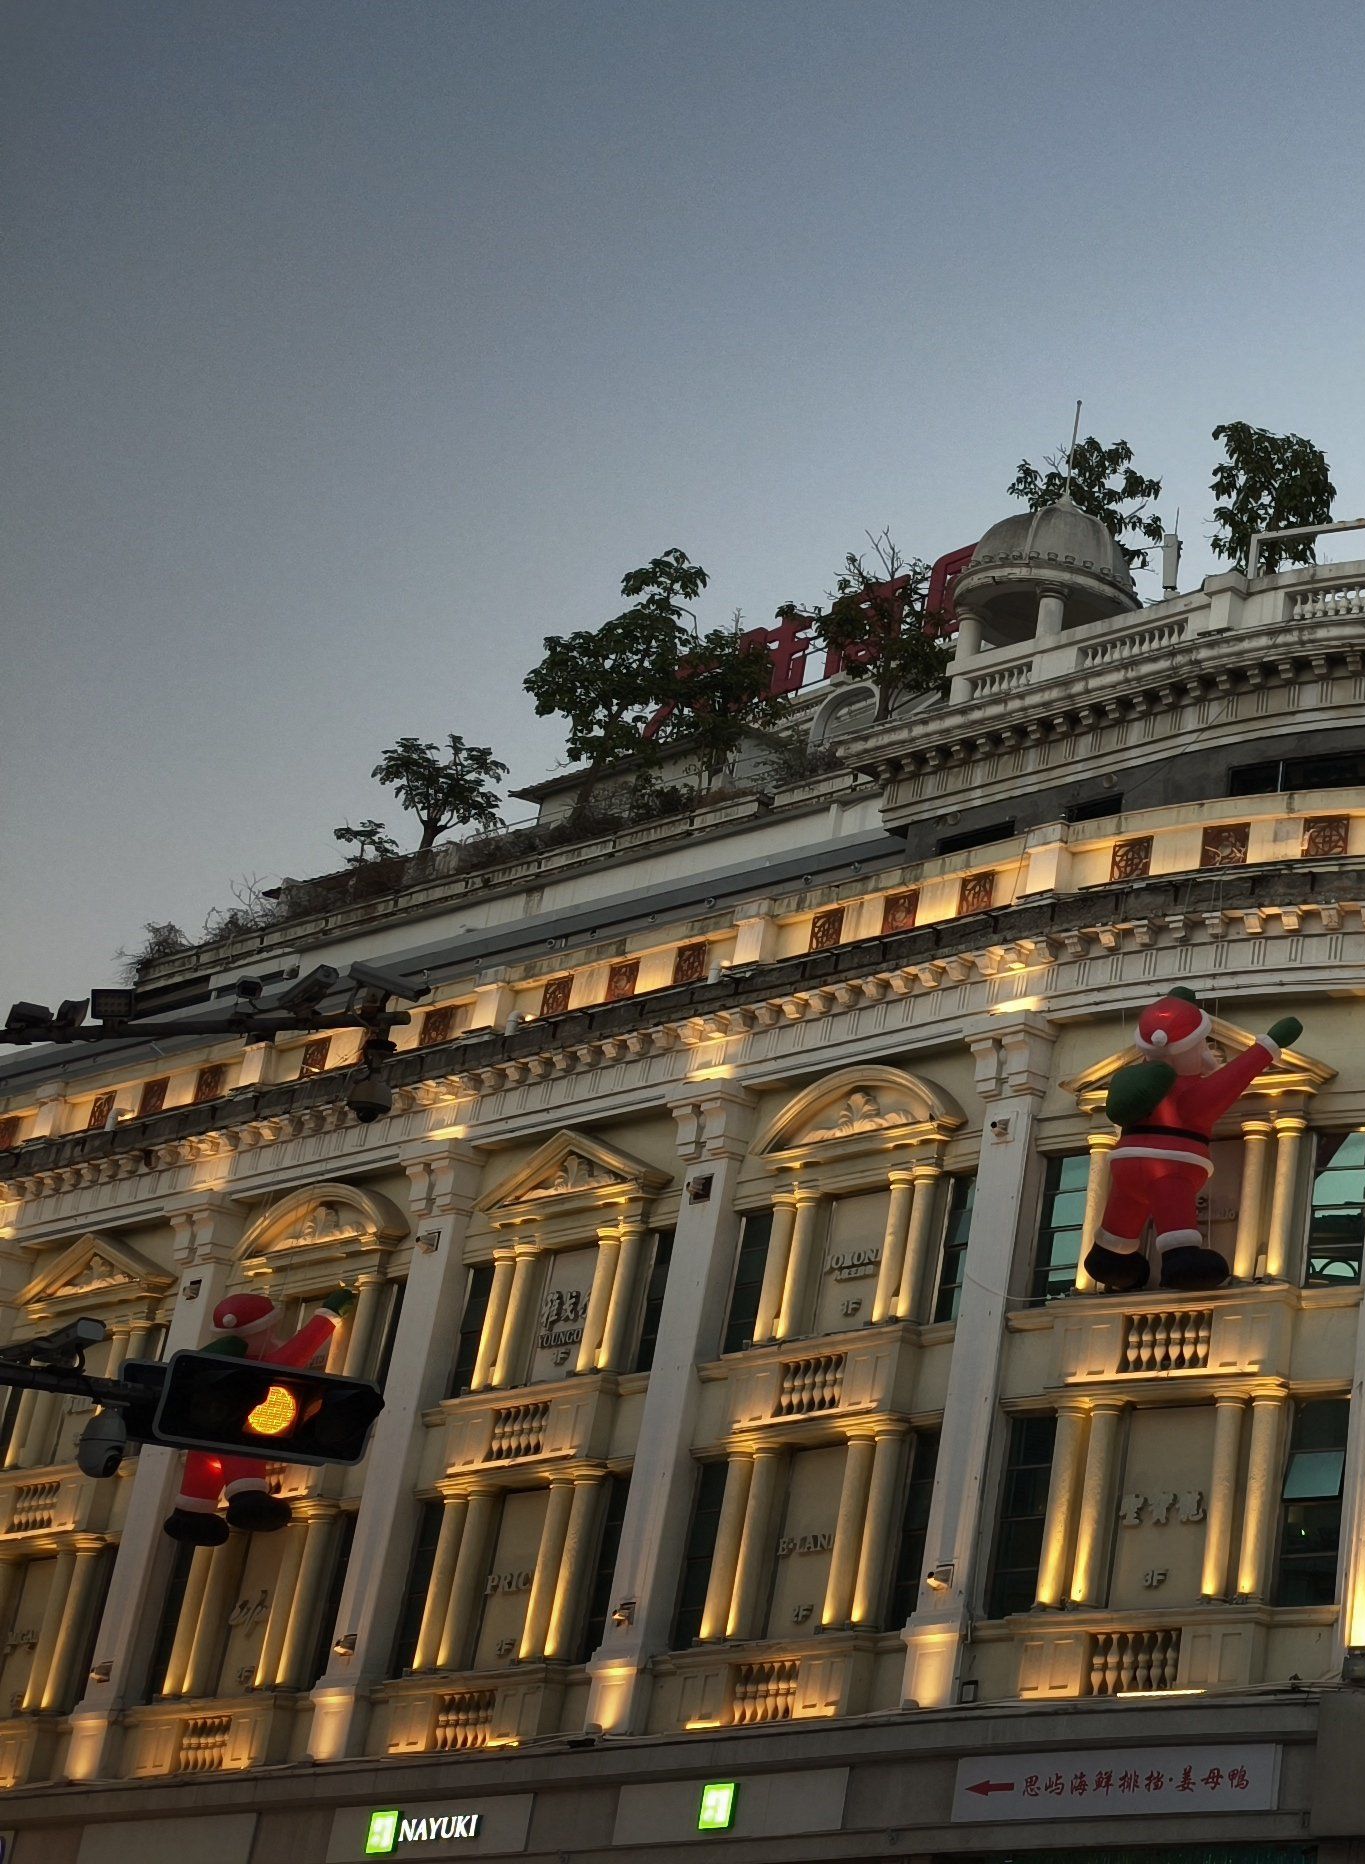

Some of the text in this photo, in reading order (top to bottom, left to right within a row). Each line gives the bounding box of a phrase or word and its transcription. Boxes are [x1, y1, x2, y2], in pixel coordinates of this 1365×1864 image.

[538, 1327, 584, 1349] YOUNGO
[484, 1571, 533, 1596] PRIC
[398, 1814, 479, 1842] NAYUKI
